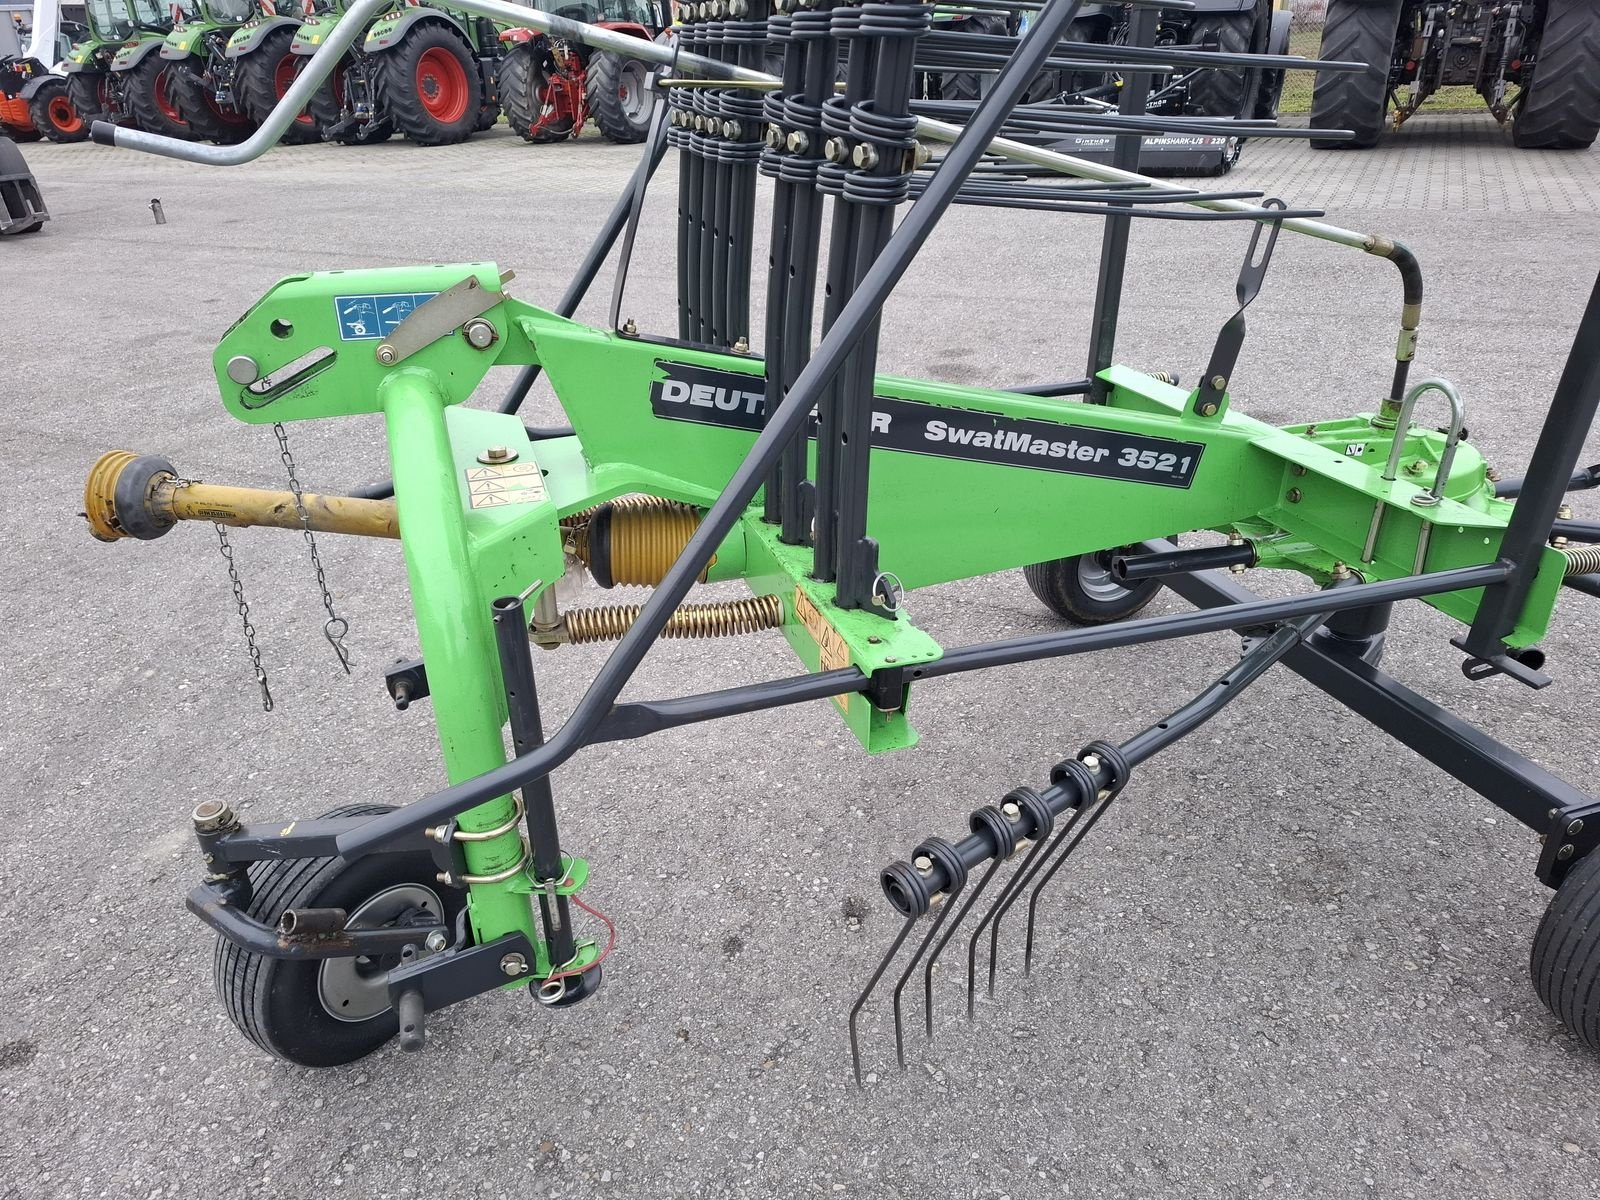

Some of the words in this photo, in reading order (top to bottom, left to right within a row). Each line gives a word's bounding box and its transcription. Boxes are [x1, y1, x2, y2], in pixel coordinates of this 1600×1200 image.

[1210, 137, 1226, 145] 220
[923, 419, 1110, 463] SwatMaster
[1117, 447, 1192, 475] 3521
